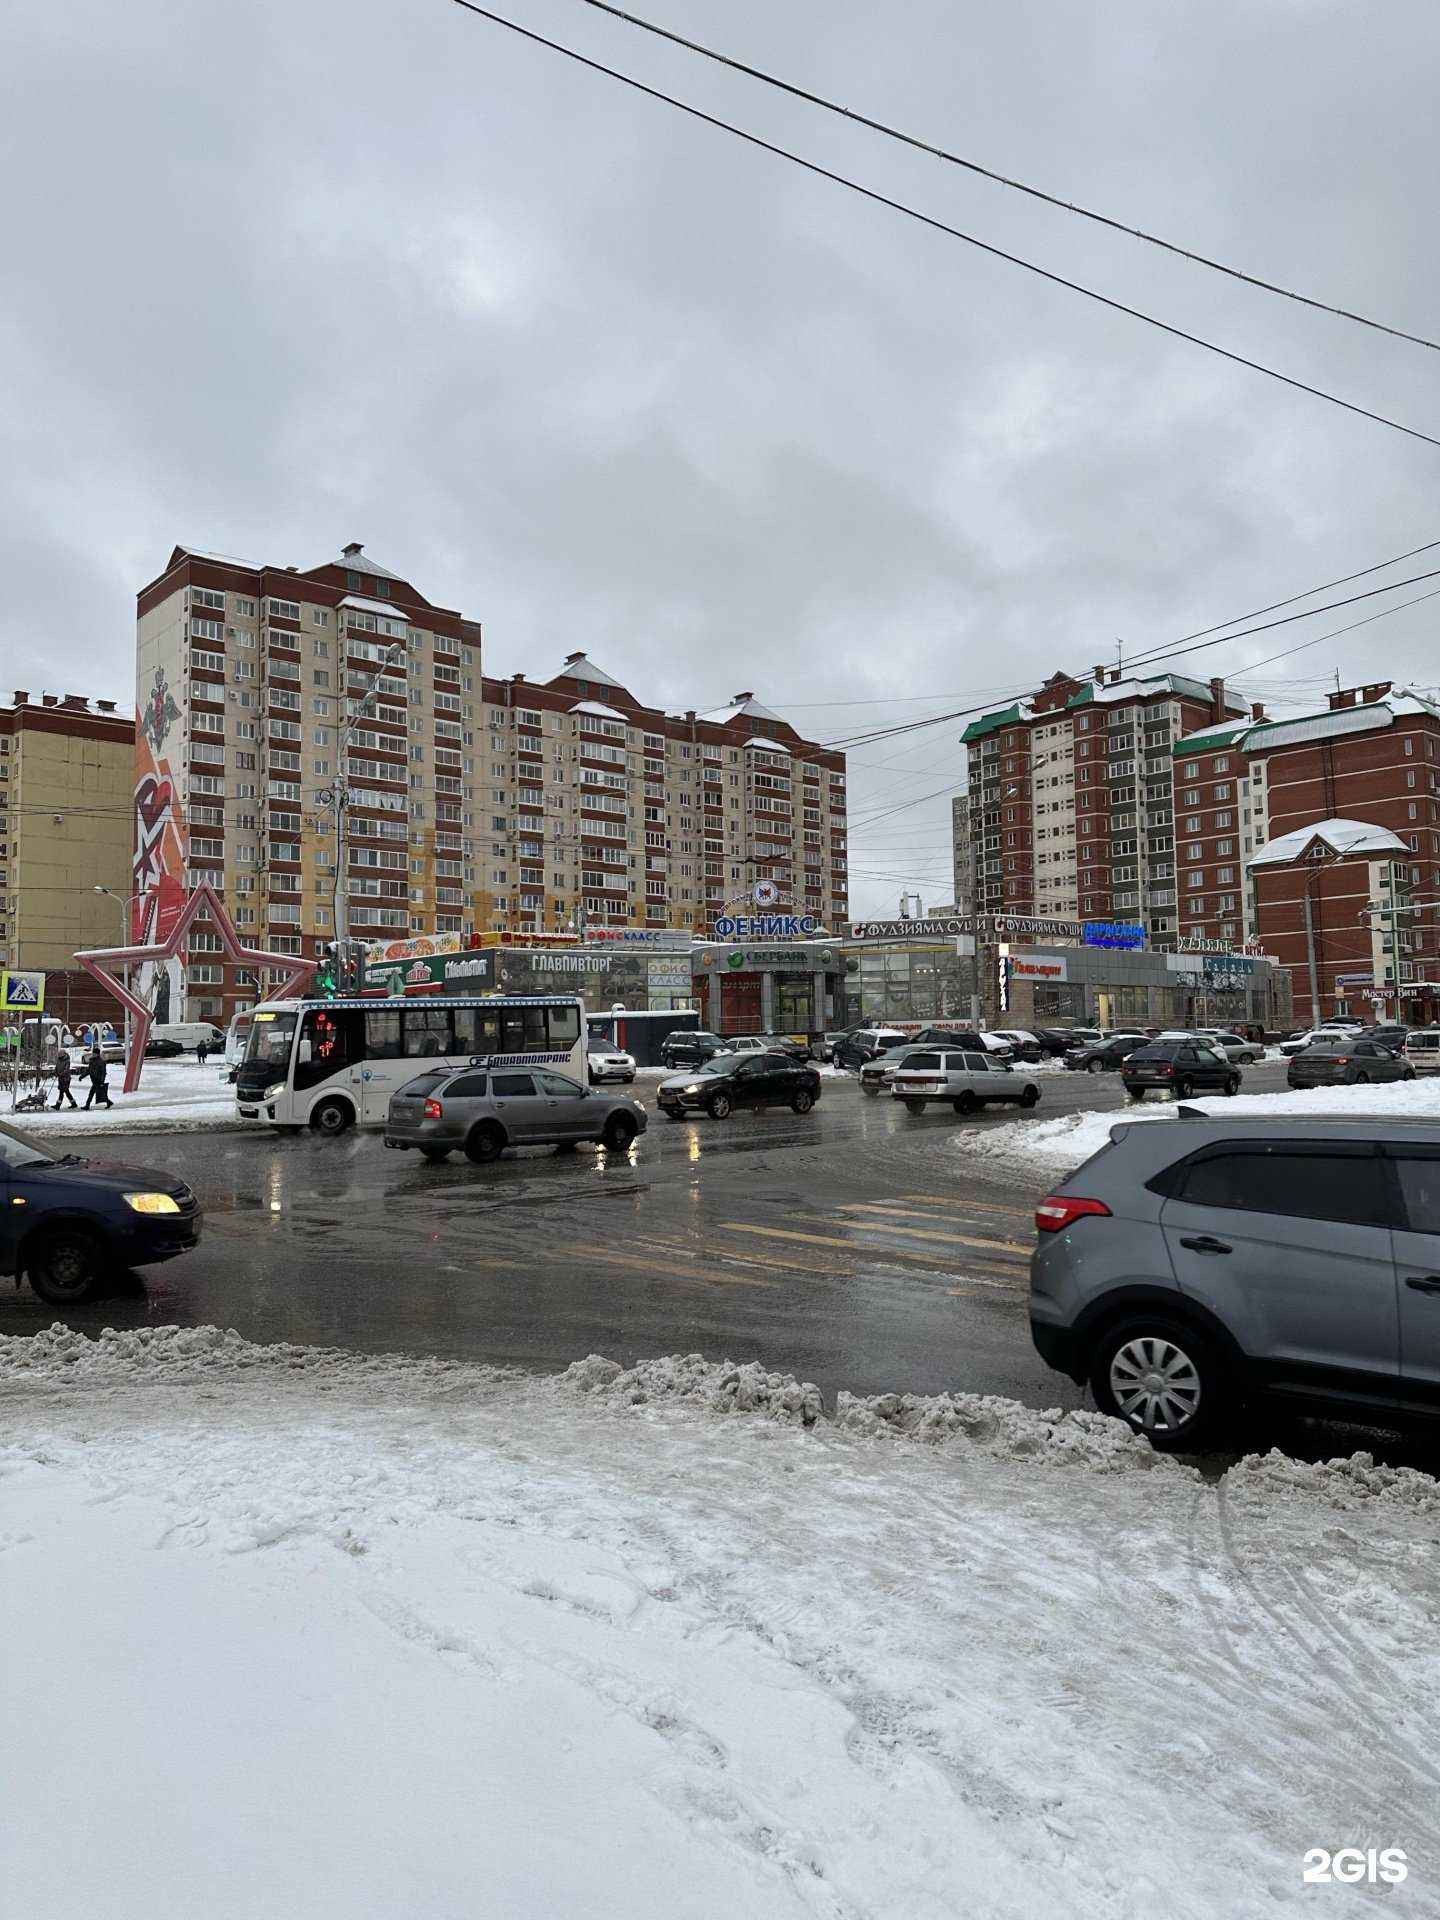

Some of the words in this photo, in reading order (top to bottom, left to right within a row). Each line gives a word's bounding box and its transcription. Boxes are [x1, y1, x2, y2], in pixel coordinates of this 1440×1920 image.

[715, 915, 815, 937] ФЕНИКС
[868, 923, 944, 938] ФУДЗИЯМА
[1006, 919, 1057, 934] ФУДЗИЯМА
[1058, 922, 1084, 936] СУШИ
[532, 955, 613, 973] ГЛАВПИВТОРГ
[746, 950, 808, 962] СБЕРБАНК
